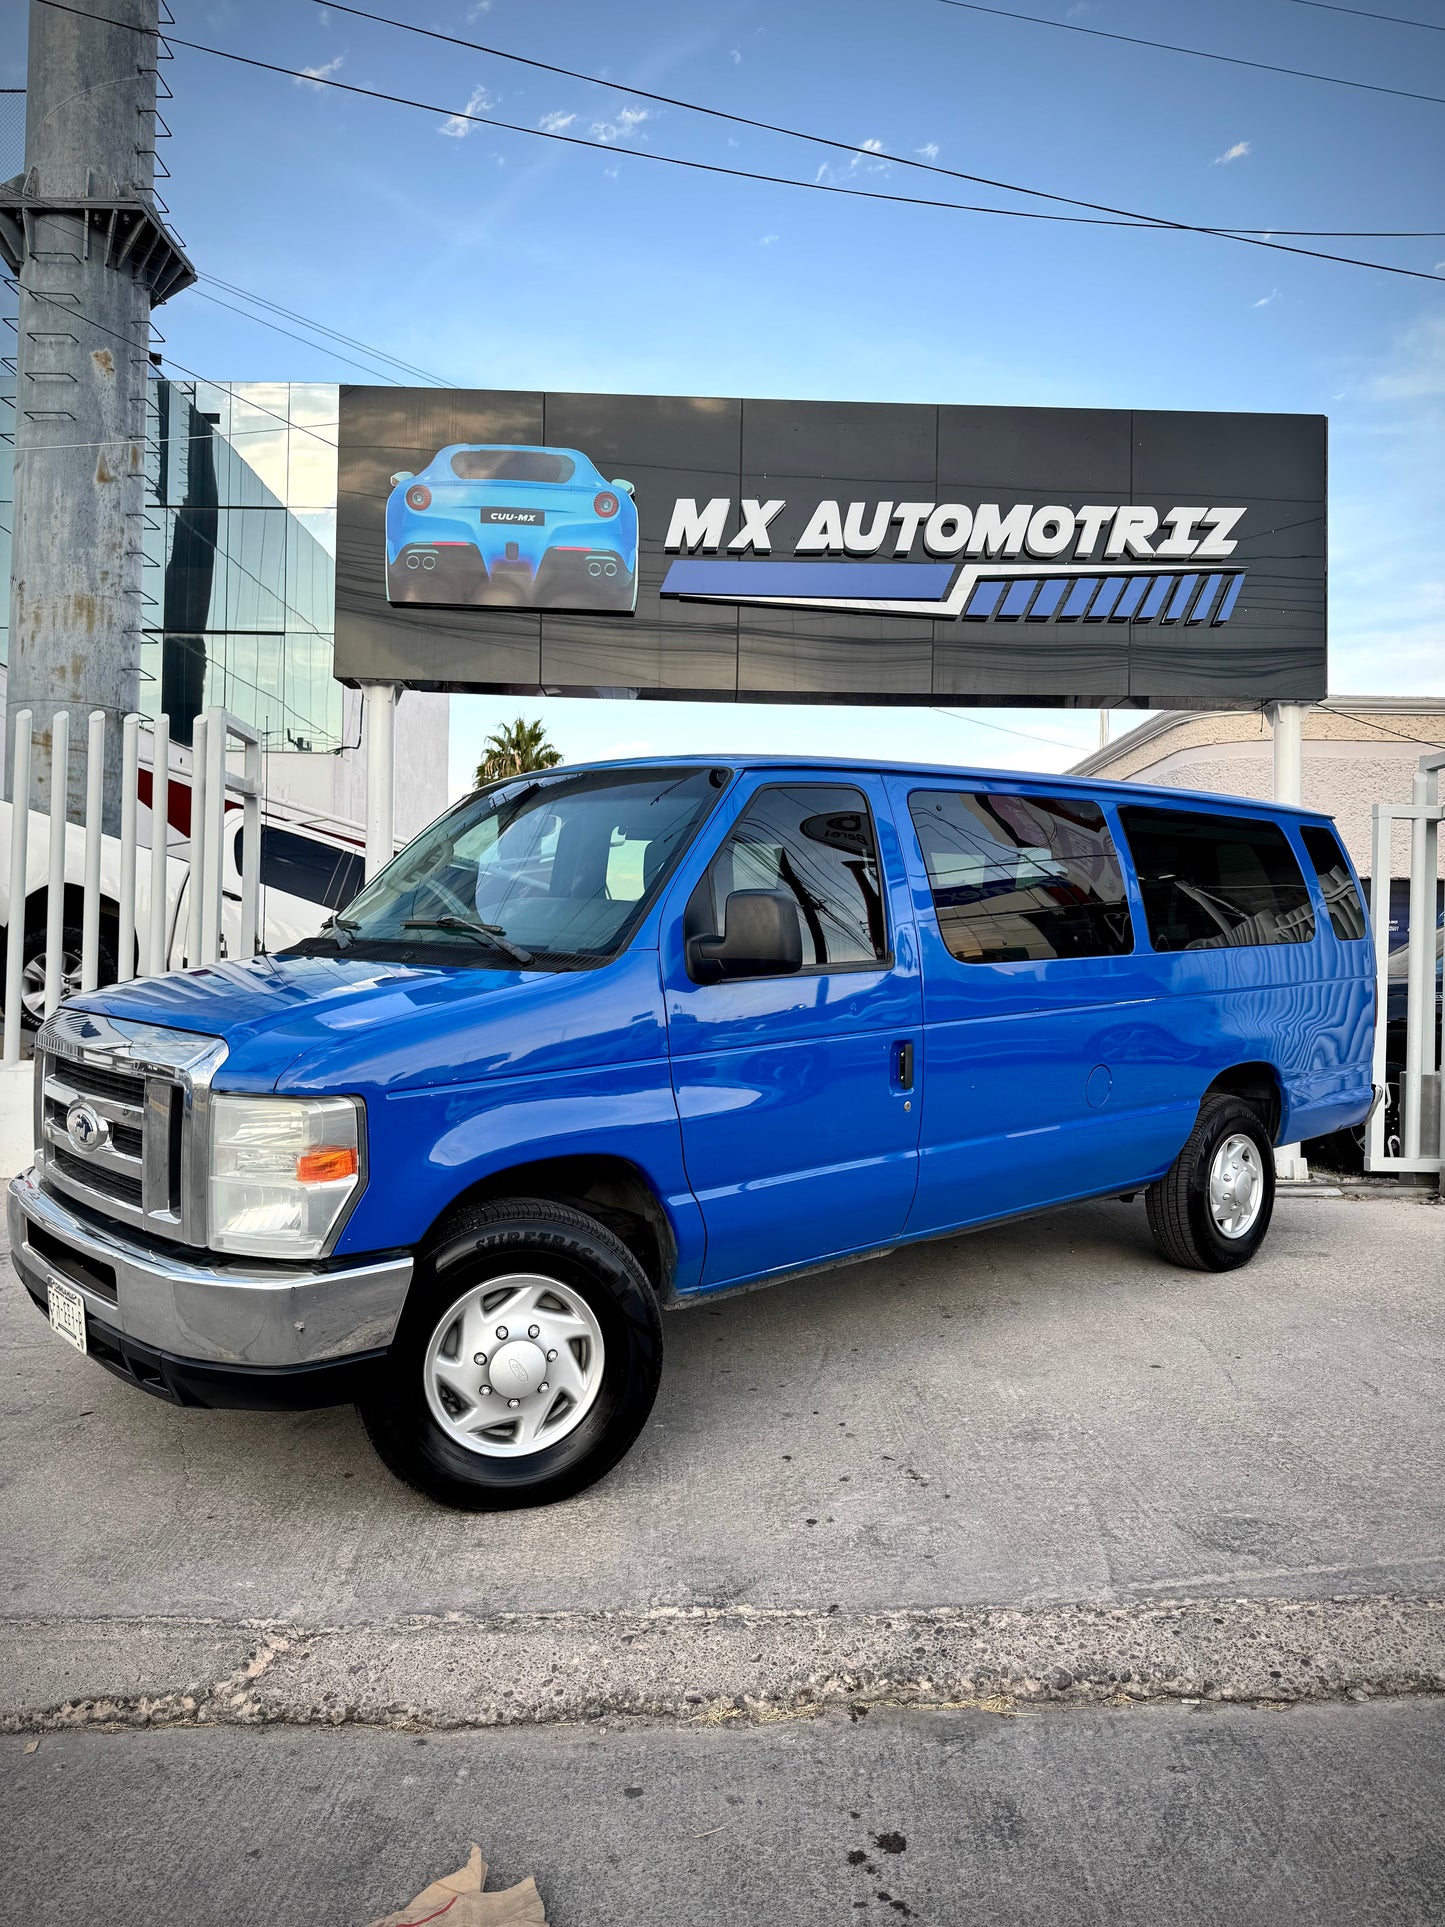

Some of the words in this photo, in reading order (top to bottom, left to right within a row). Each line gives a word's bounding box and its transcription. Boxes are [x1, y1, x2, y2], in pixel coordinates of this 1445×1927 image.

[490, 512, 537, 522] CUU-MX
[664, 499, 786, 554] MX
[794, 500, 1247, 559] AUTOMOTRIZ
